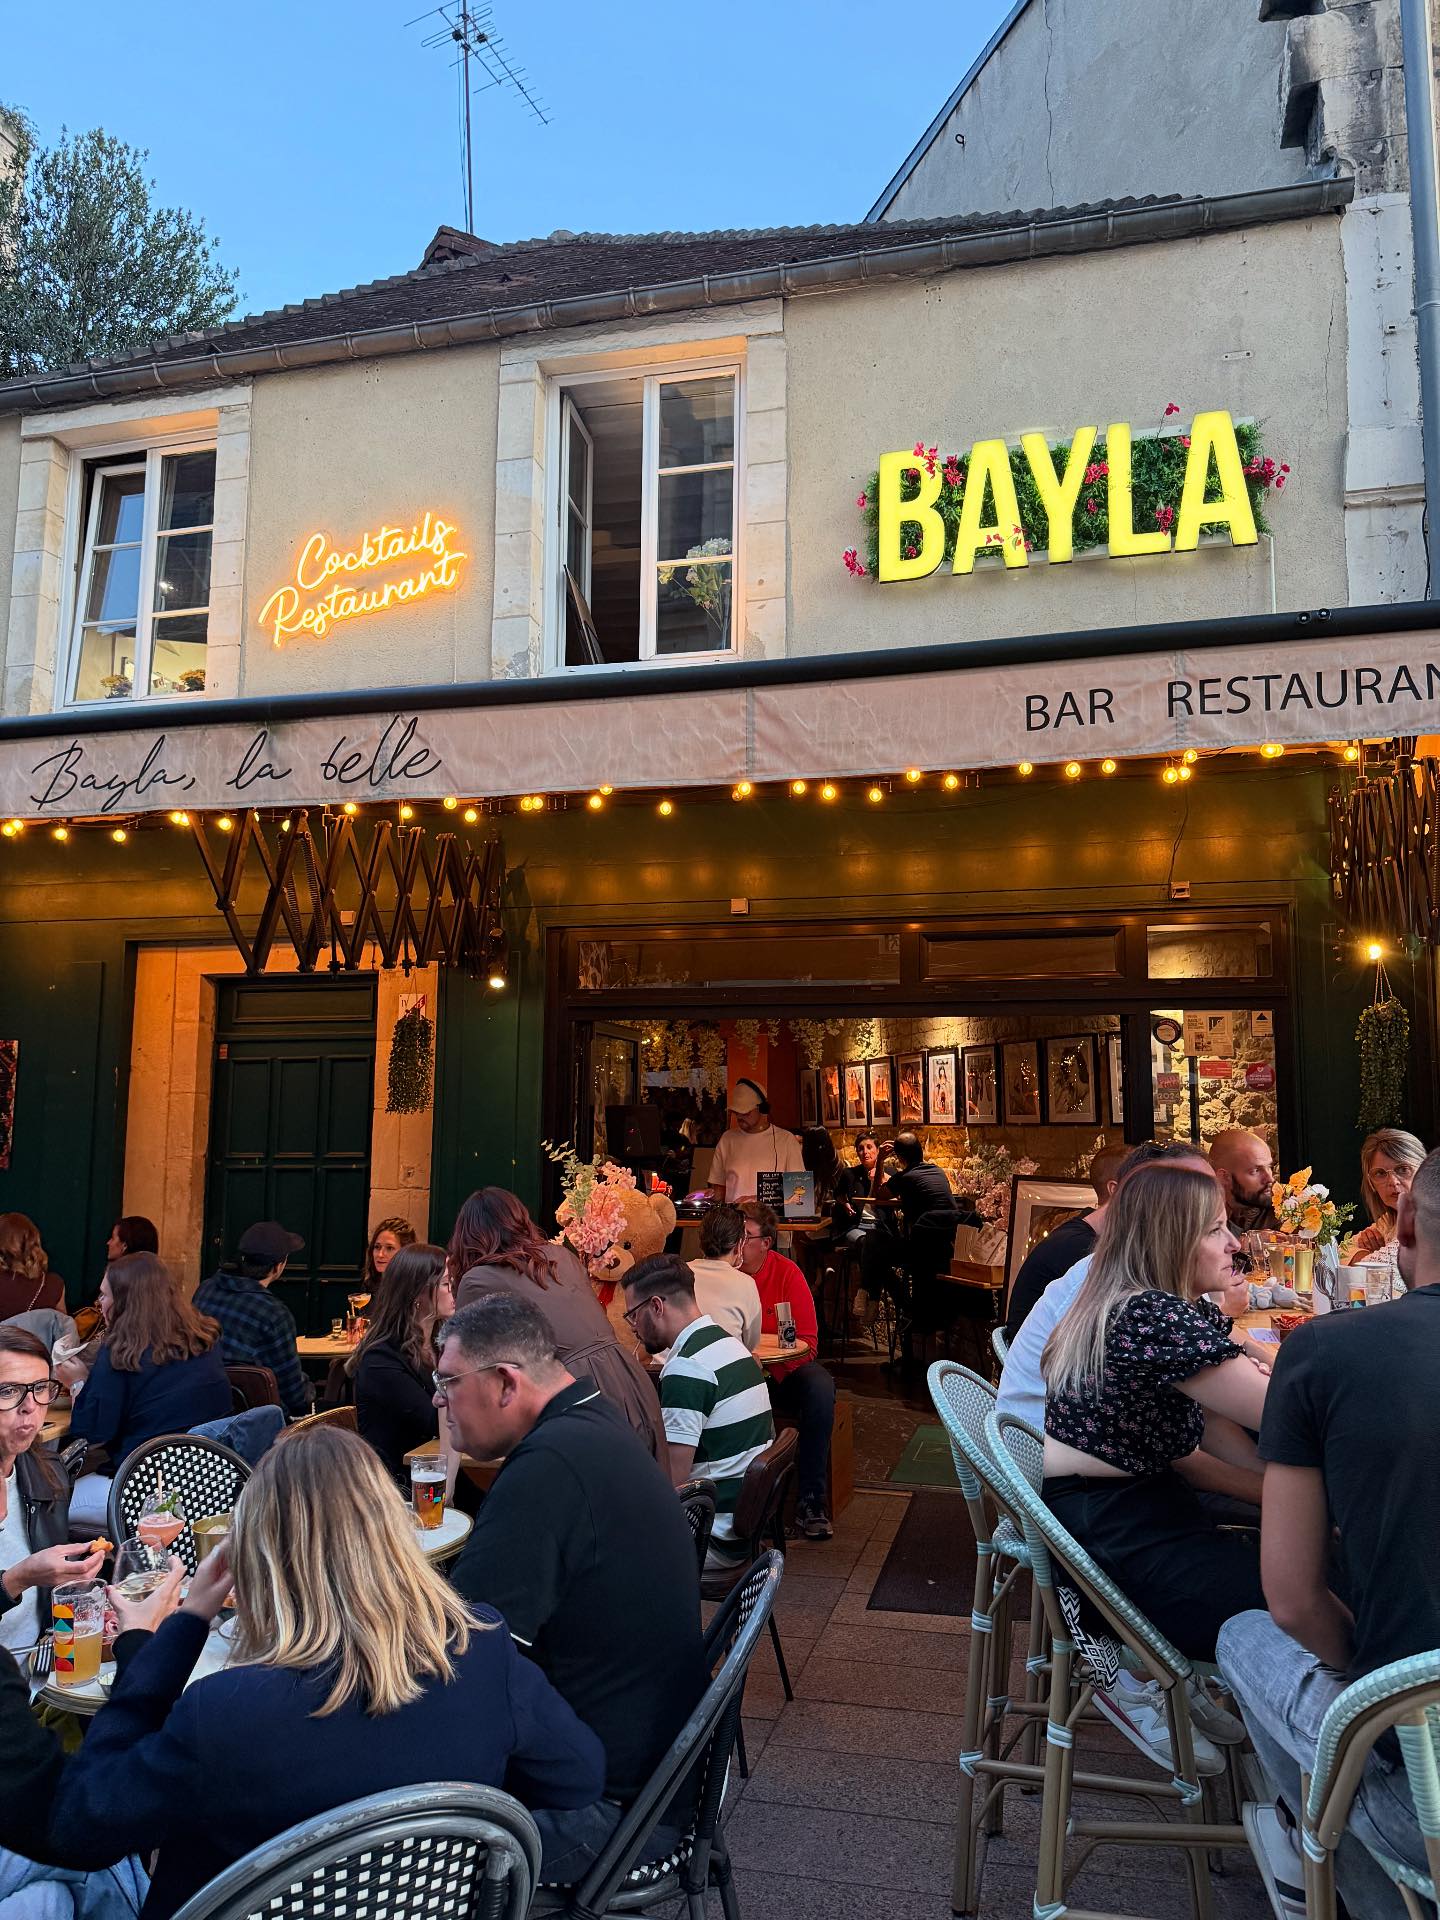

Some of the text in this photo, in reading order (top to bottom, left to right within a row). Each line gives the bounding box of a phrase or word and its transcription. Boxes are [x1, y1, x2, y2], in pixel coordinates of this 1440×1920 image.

[879, 410, 1258, 584] BAYLA
[297, 511, 458, 590] Cocktails
[257, 551, 467, 648] Restaurant
[1025, 688, 1115, 732] BAR
[30, 714, 442, 813] Bayla, la belle
